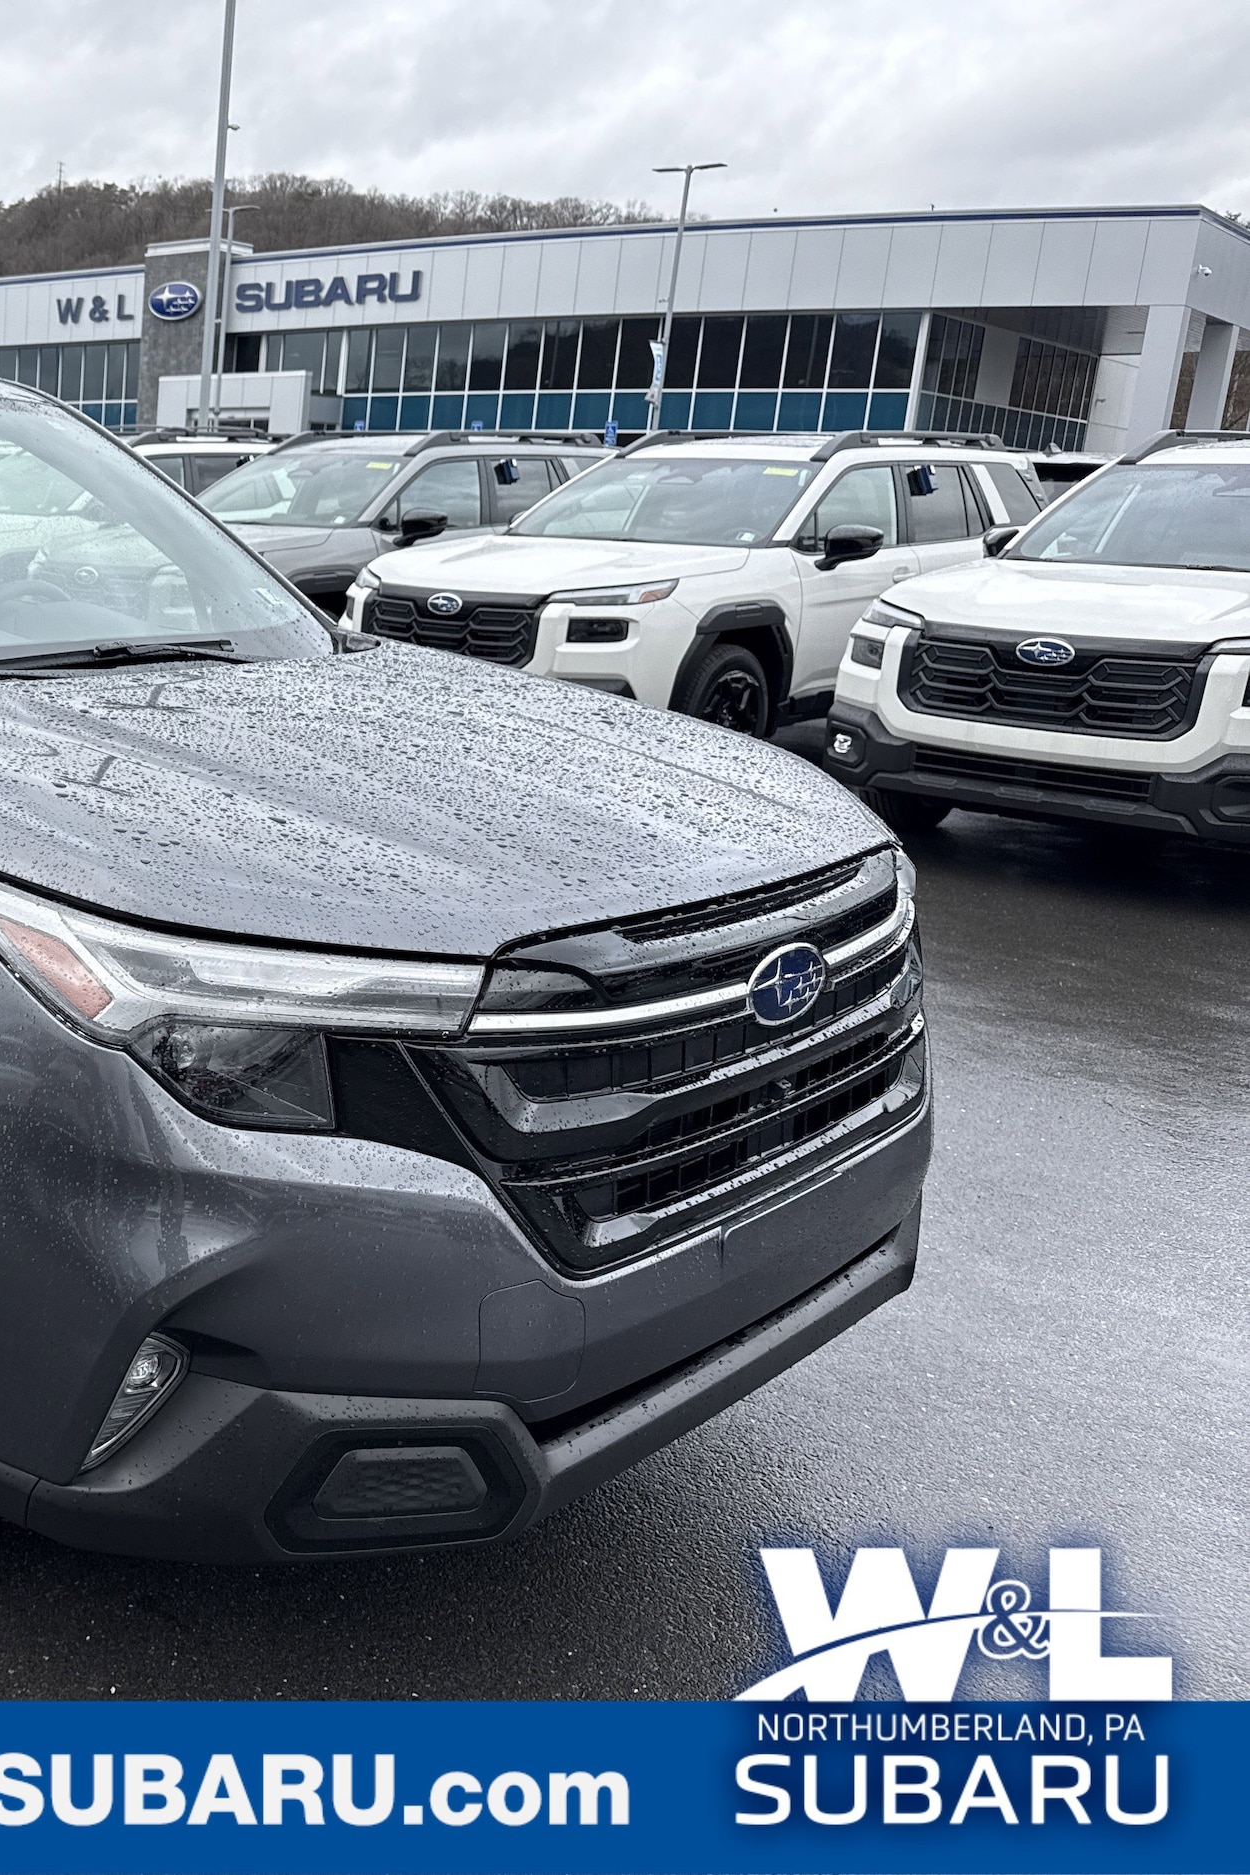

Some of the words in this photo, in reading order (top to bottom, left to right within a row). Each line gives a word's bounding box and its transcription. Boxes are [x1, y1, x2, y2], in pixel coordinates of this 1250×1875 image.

[56, 297, 85, 325] W
[88, 295, 110, 322] &
[116, 294, 135, 320] L
[234, 270, 422, 314] SUBARU
